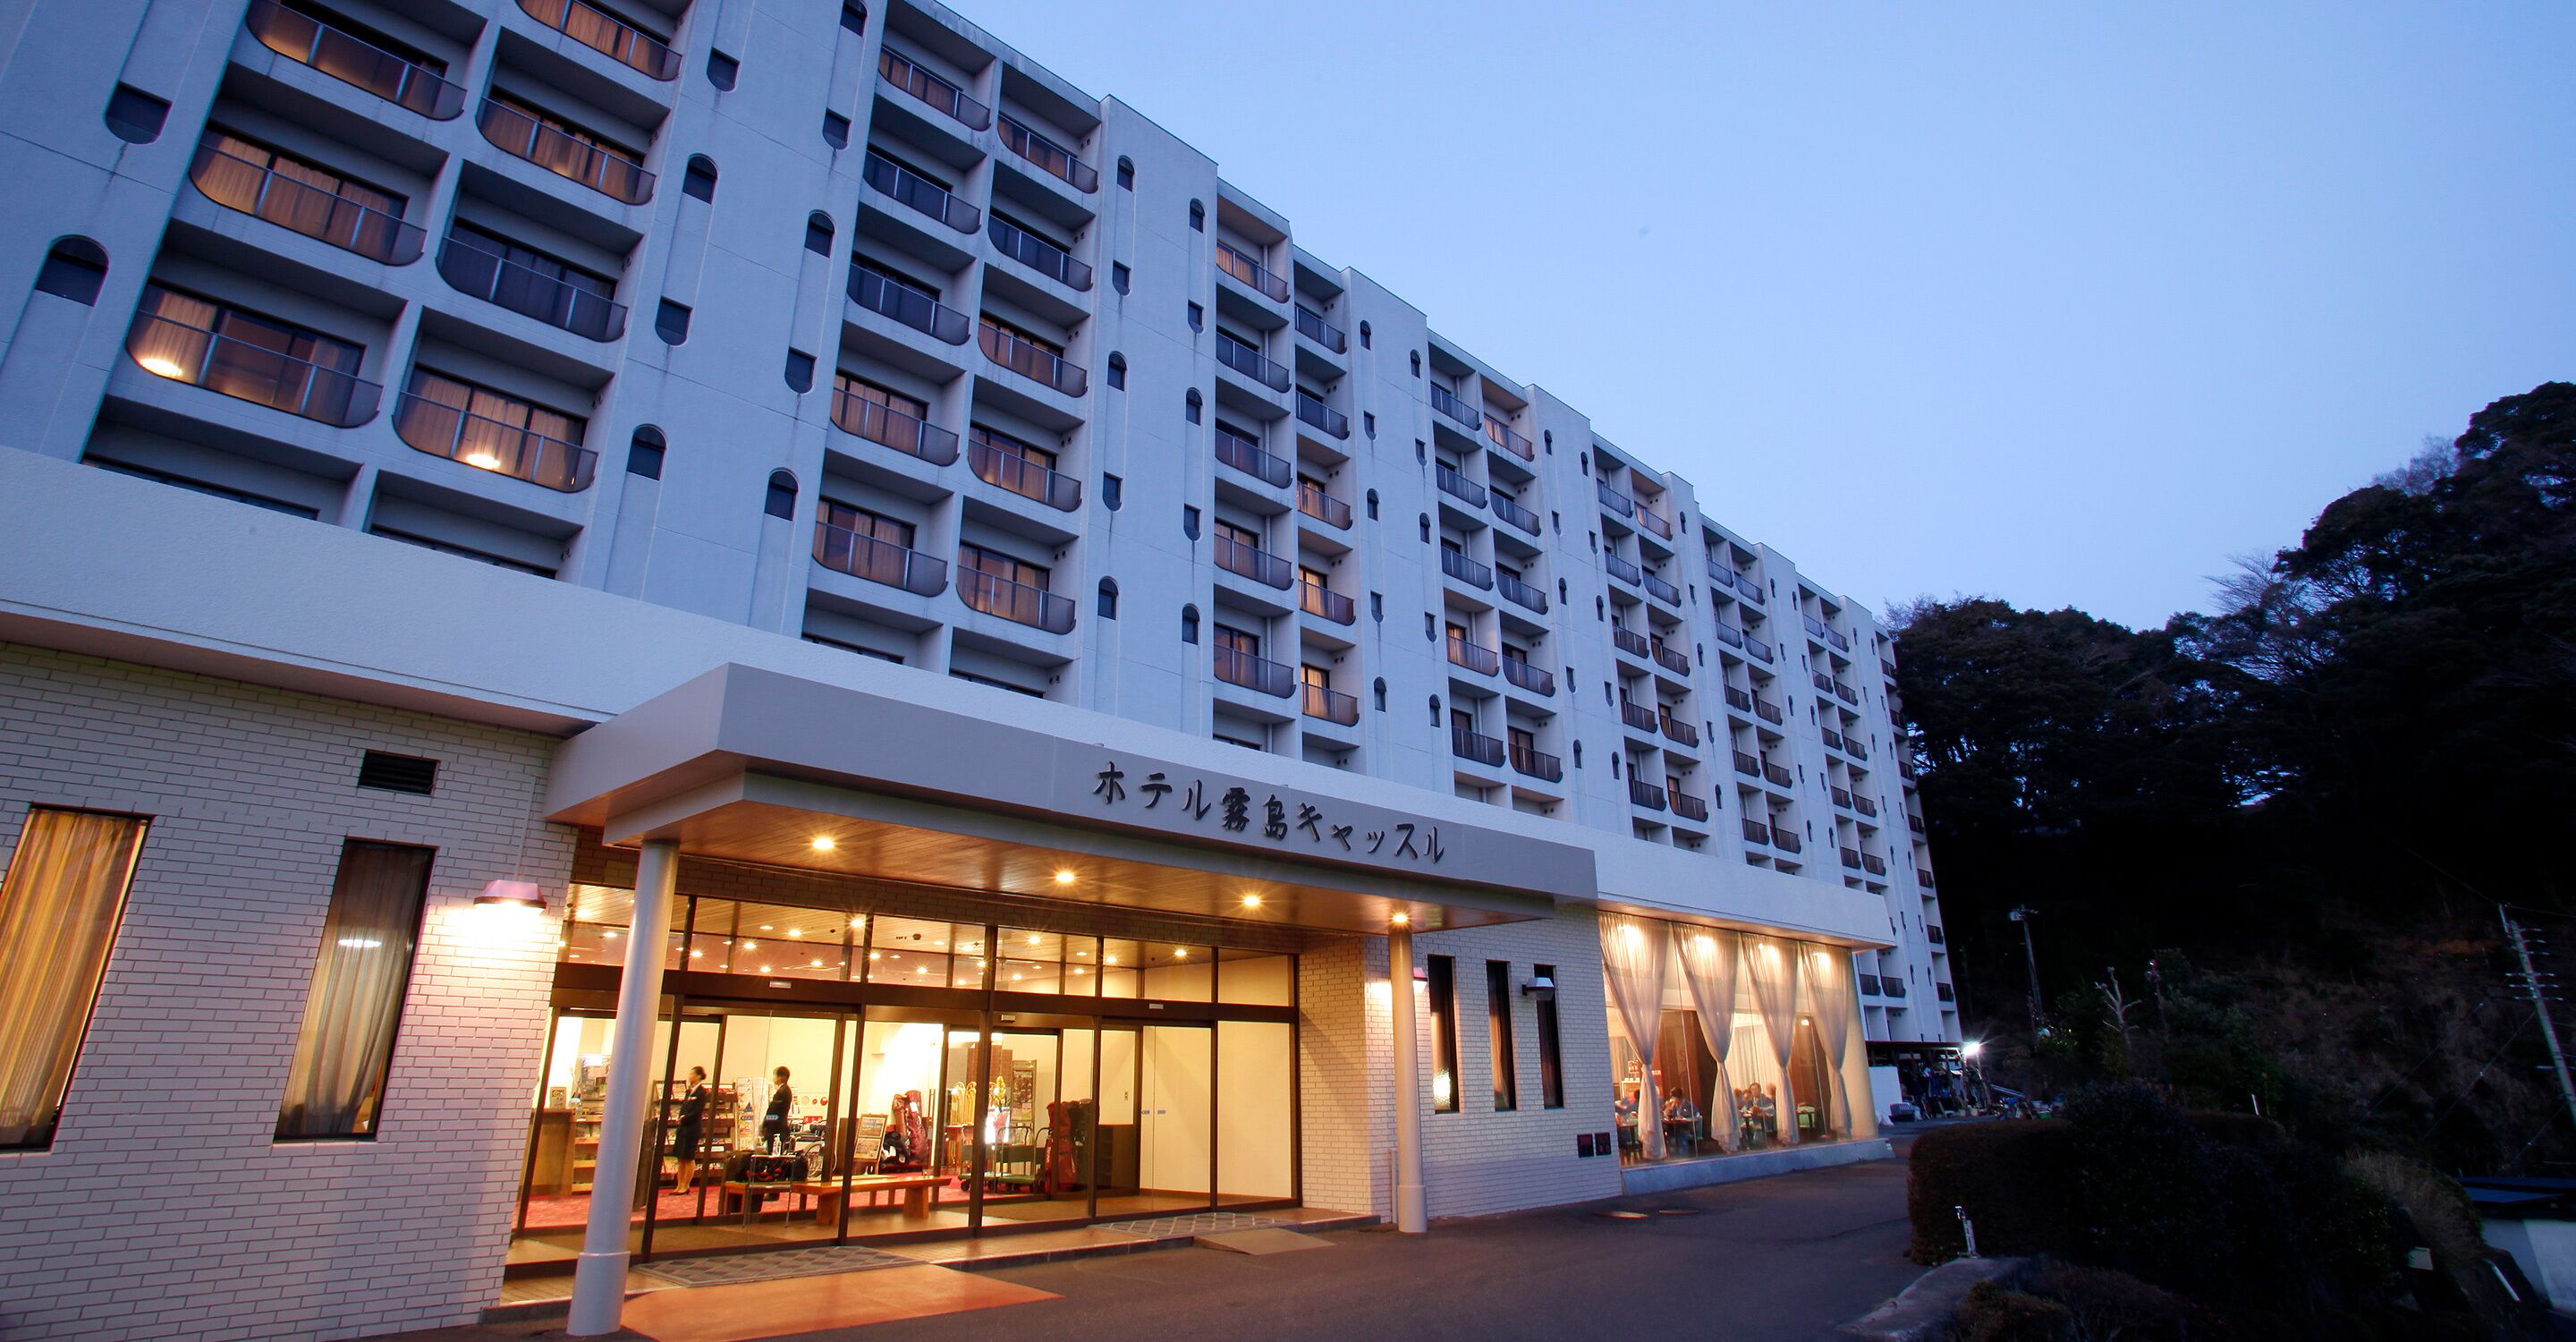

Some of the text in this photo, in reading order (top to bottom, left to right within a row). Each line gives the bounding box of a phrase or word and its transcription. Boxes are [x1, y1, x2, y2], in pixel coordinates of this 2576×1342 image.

[1093, 761, 1445, 863] ホテル霧島キャッスル
